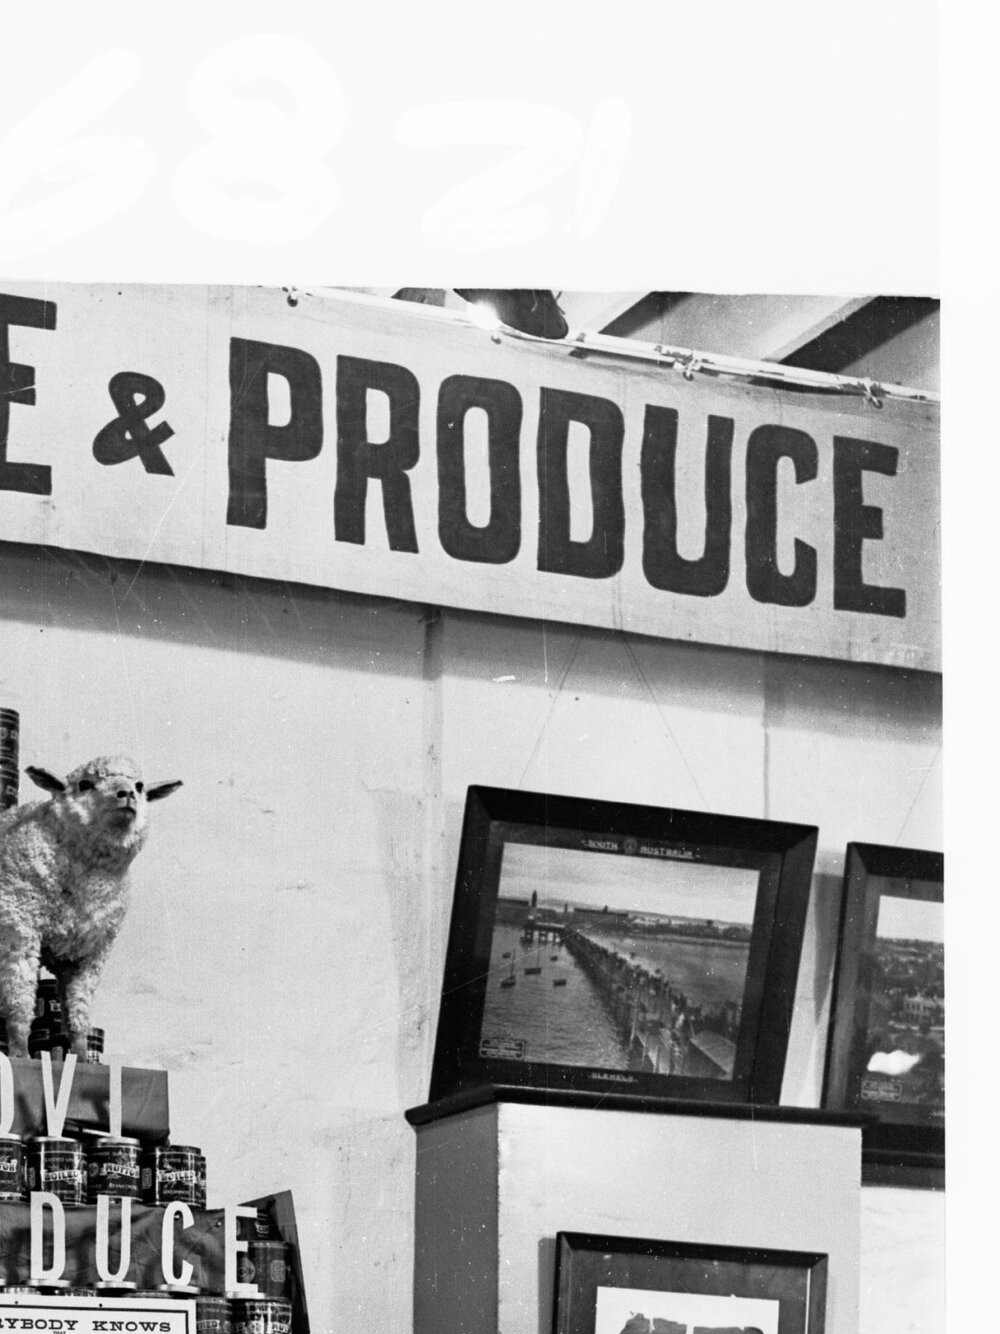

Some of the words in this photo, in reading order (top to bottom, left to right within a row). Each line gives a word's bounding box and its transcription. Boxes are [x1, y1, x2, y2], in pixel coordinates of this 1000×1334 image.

[93, 371, 174, 477] &
[226, 337, 907, 618] PRODUCE
[640, 846, 694, 860] AUSTRALIA
[92, 1320, 171, 1333] KNOWS
